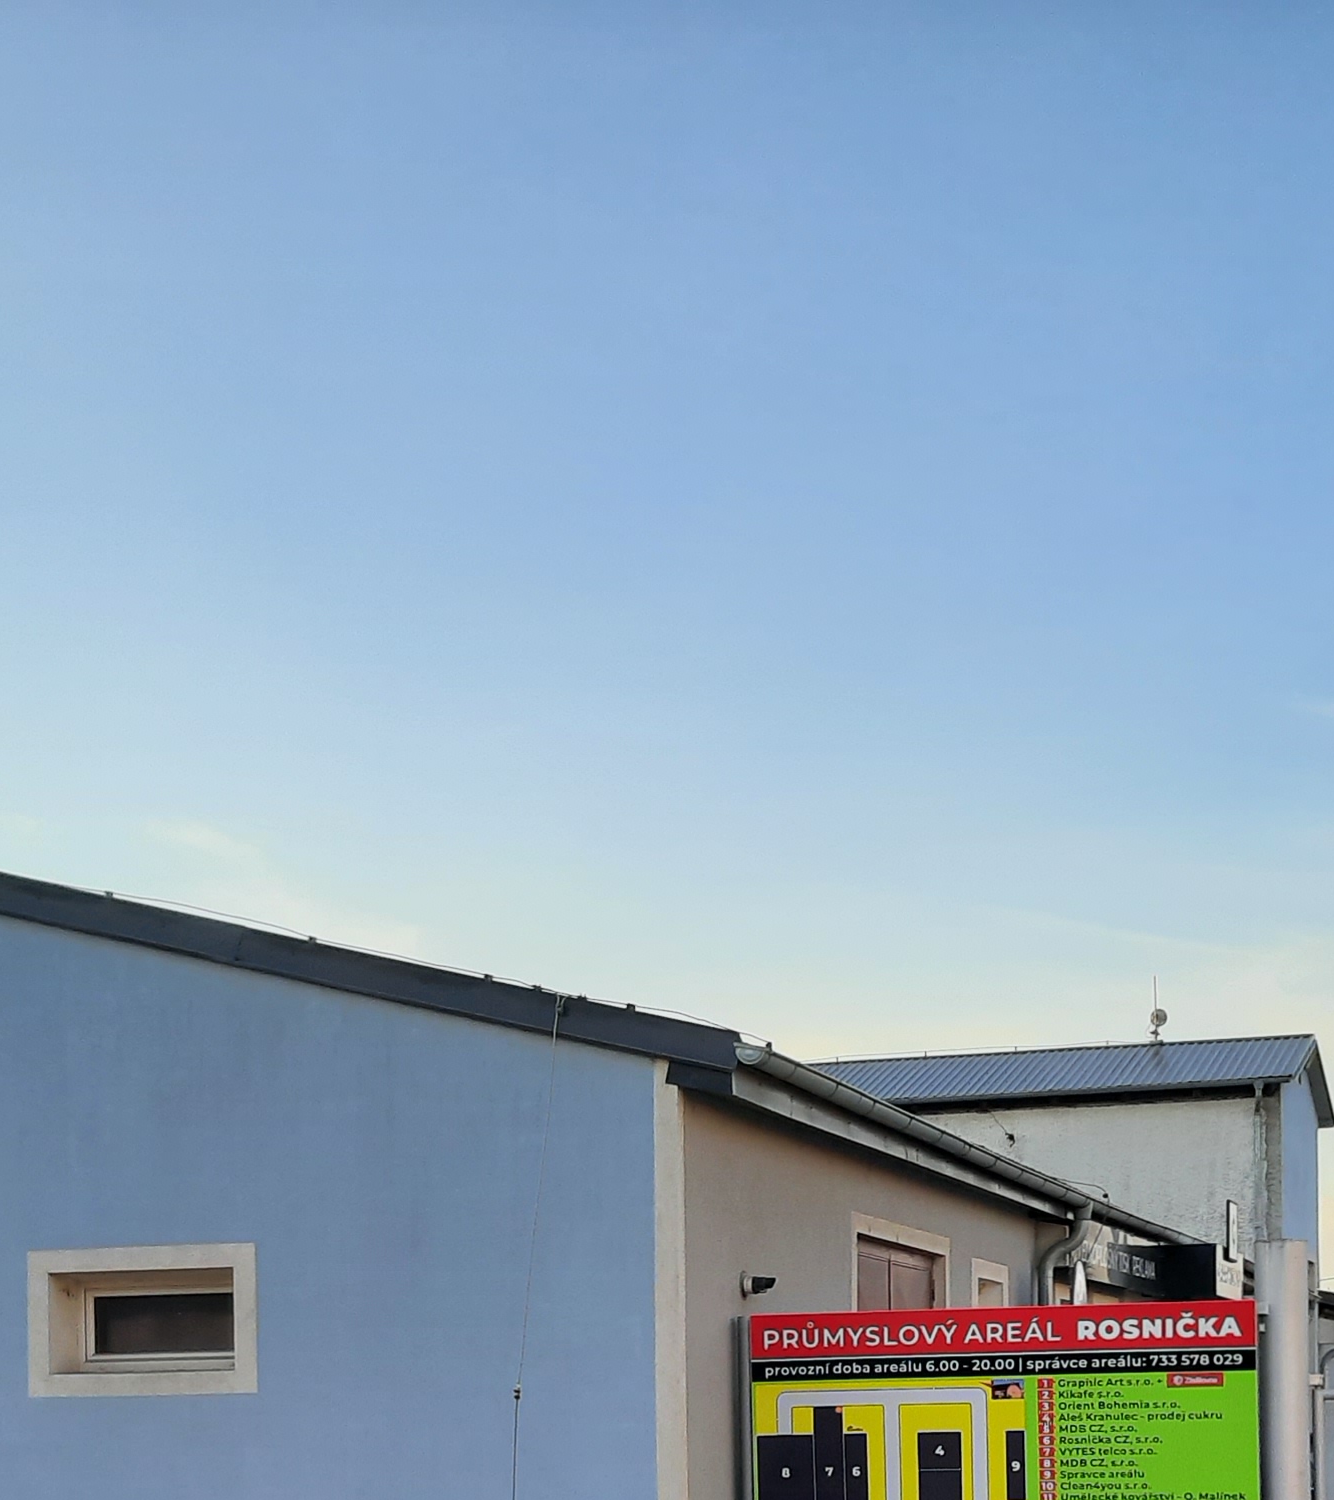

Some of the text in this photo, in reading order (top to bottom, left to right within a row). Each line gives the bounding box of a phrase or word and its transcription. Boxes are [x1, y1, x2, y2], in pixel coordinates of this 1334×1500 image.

[763, 1311, 1243, 1350] PRŮMYSLOVÝ AREÁL ROSNIČKA
[765, 1362, 830, 1379] provozní
[833, 1362, 871, 1375] doba
[874, 1360, 922, 1373] areálu
[925, 1360, 959, 1372] 6.00
[971, 1358, 1015, 1371] 20.00
[1026, 1356, 1088, 1372] správce
[1091, 1354, 1147, 1368] areálu:
[1150, 1354, 1178, 1367] 733
[1181, 1354, 1210, 1366] 578
[1213, 1354, 1243, 1366] 029
[1042, 1378, 1049, 1388] 1
[1106, 1378, 1125, 1387] Art
[1041, 1391, 1050, 1400] 2
[1058, 1390, 1095, 1399] Kikafe
[1041, 1401, 1050, 1411] 3
[1058, 1402, 1095, 1411] Orient
[1098, 1400, 1150, 1410] Bohemia
[1147, 1411, 1186, 1422] prodej
[1188, 1411, 1223, 1420] cukru
[1042, 1435, 1051, 1444] 6
[1059, 1435, 1112, 1445] Rosnička
[934, 1445, 945, 1456] 4
[1042, 1447, 1051, 1457] 7
[1058, 1447, 1096, 1456] VYTES
[1011, 1461, 1021, 1472] 9
[1042, 1458, 1052, 1468] 8
[781, 1467, 791, 1478] 8
[824, 1466, 834, 1477] 7
[852, 1466, 861, 1477] 6
[1042, 1470, 1052, 1479] 9
[1041, 1481, 1054, 1490] 10
